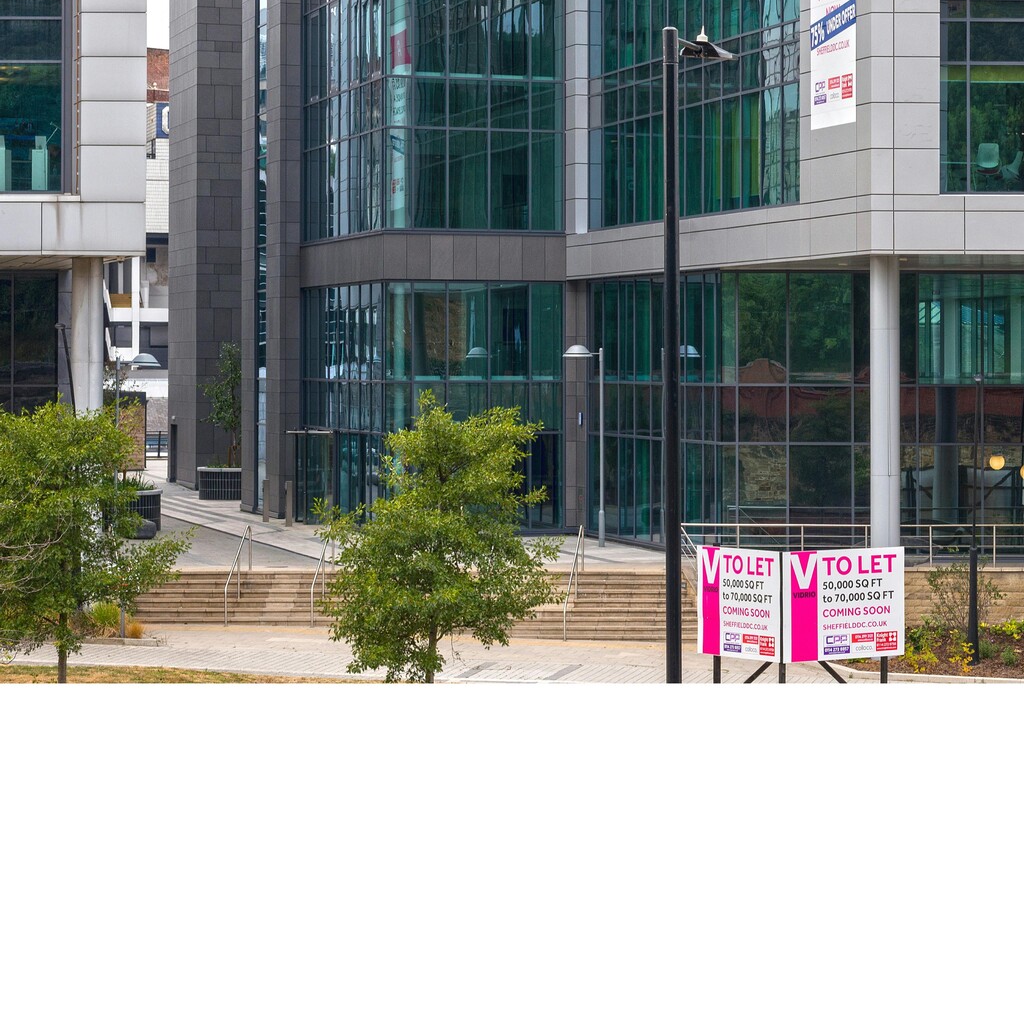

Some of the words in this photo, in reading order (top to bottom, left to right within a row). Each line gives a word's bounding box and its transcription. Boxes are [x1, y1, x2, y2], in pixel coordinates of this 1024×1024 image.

[810, 21, 825, 48] 75%
[826, 12, 841, 35] UNDER
[841, 4, 856, 24] OFFER
[723, 555, 743, 574] TO
[747, 556, 774, 577] LET
[790, 553, 817, 589] V
[822, 556, 852, 576] TO
[858, 554, 897, 574] LET
[723, 579, 744, 589] 50,000
[745, 580, 754, 589] SQ
[756, 581, 764, 590] FT
[822, 580, 854, 591] 50,000
[855, 579, 869, 588] SQ
[871, 578, 882, 587] FT
[723, 592, 729, 600] to
[731, 592, 752, 602] 70,000
[753, 594, 762, 603] SQ
[764, 595, 772, 604] FT
[823, 594, 833, 603] to
[835, 592, 865, 603] 70,000
[867, 591, 880, 600] SQ
[883, 590, 894, 600] FT
[723, 606, 749, 616] COMING
[750, 608, 770, 618] SOON
[823, 607, 861, 618] COMING
[863, 605, 891, 615] SOON
[723, 620, 768, 631] SHEFFIELDDC.CO.UK
[823, 620, 887, 630] SHEFFIELDDC.CO.UK
